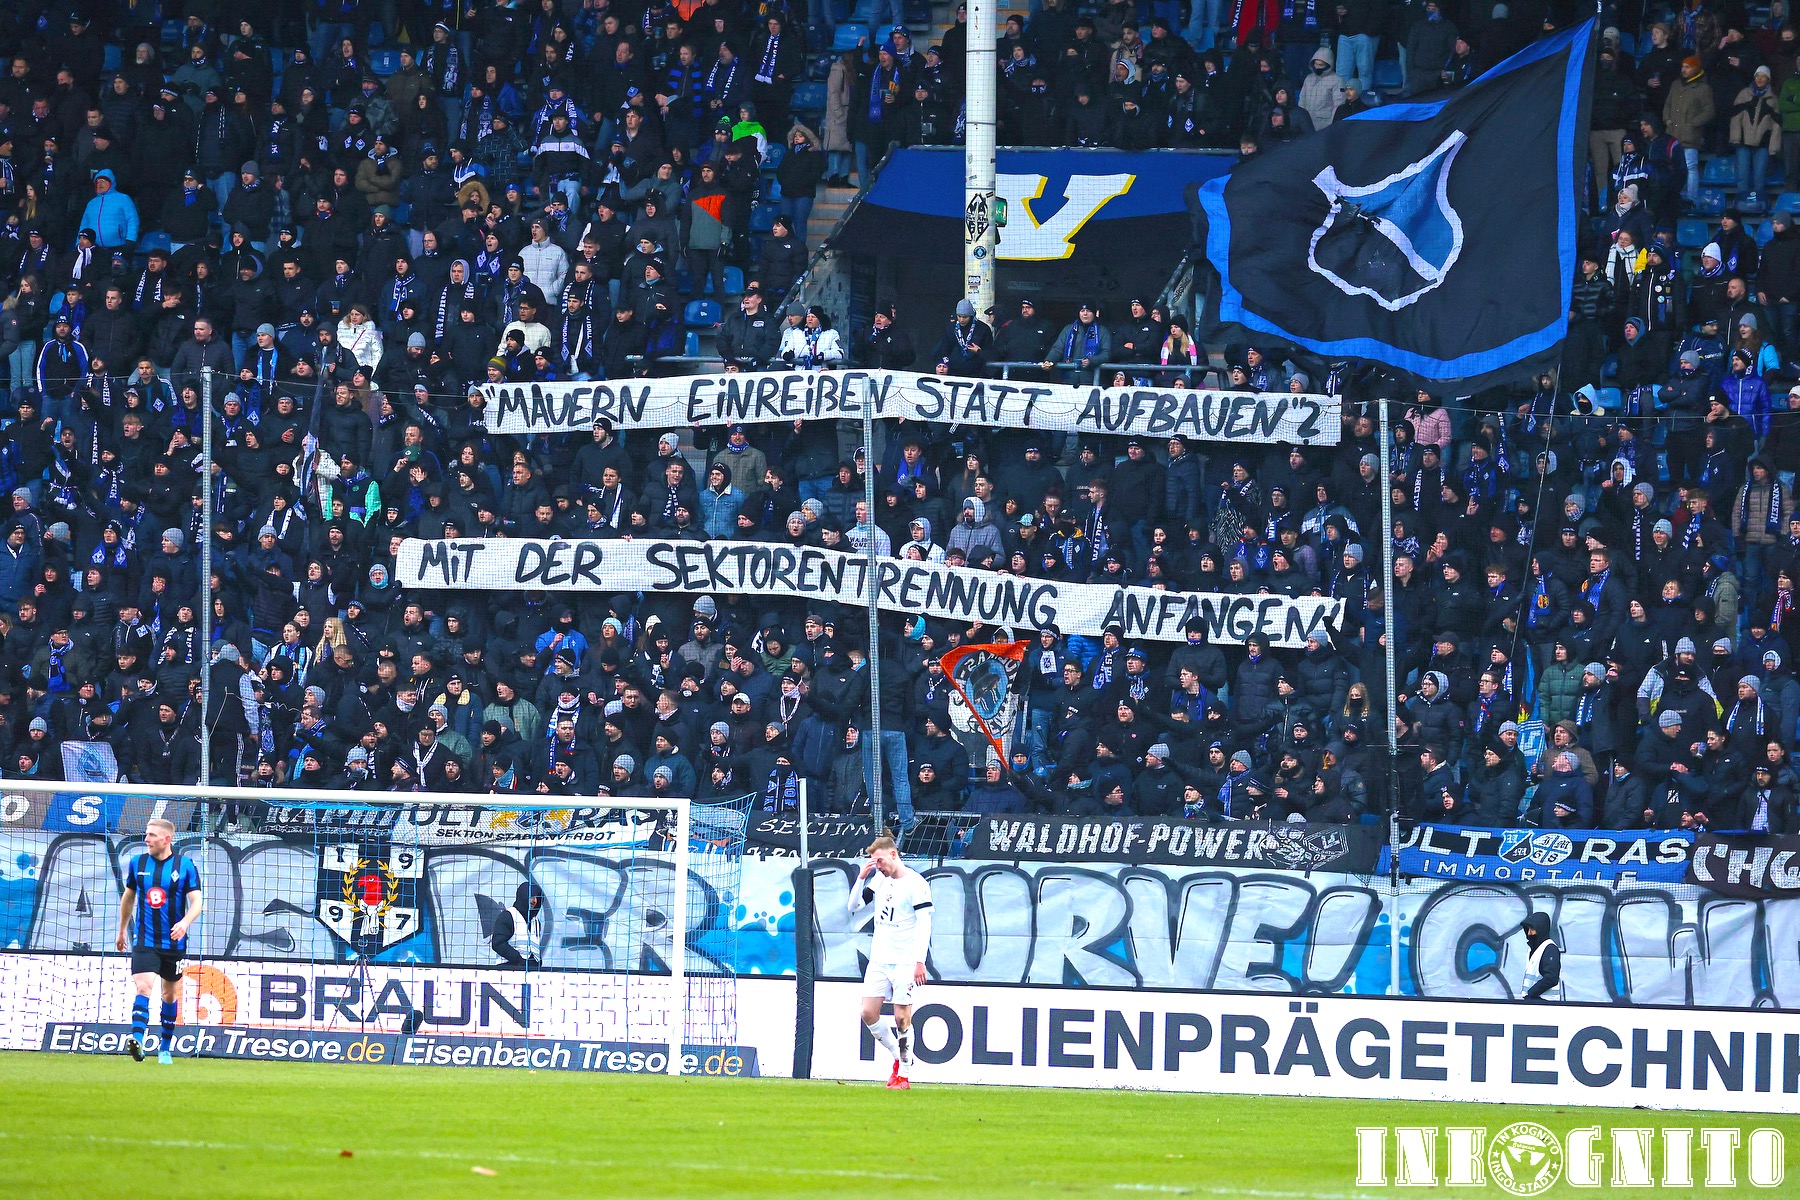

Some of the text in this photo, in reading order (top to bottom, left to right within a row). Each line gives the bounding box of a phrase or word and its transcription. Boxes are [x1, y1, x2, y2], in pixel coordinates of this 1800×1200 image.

[915, 376, 1053, 425] STATT
[514, 542, 603, 585] DER
[436, 828, 494, 840] SEKTION
[989, 818, 1265, 862] WALDHOF-POWER
[1579, 837, 1690, 866] RAS
[260, 974, 531, 1028] BRAUN
[223, 1029, 386, 1062] Tresore.de
[402, 1036, 744, 1076] Eisenbach Tresoe.de
